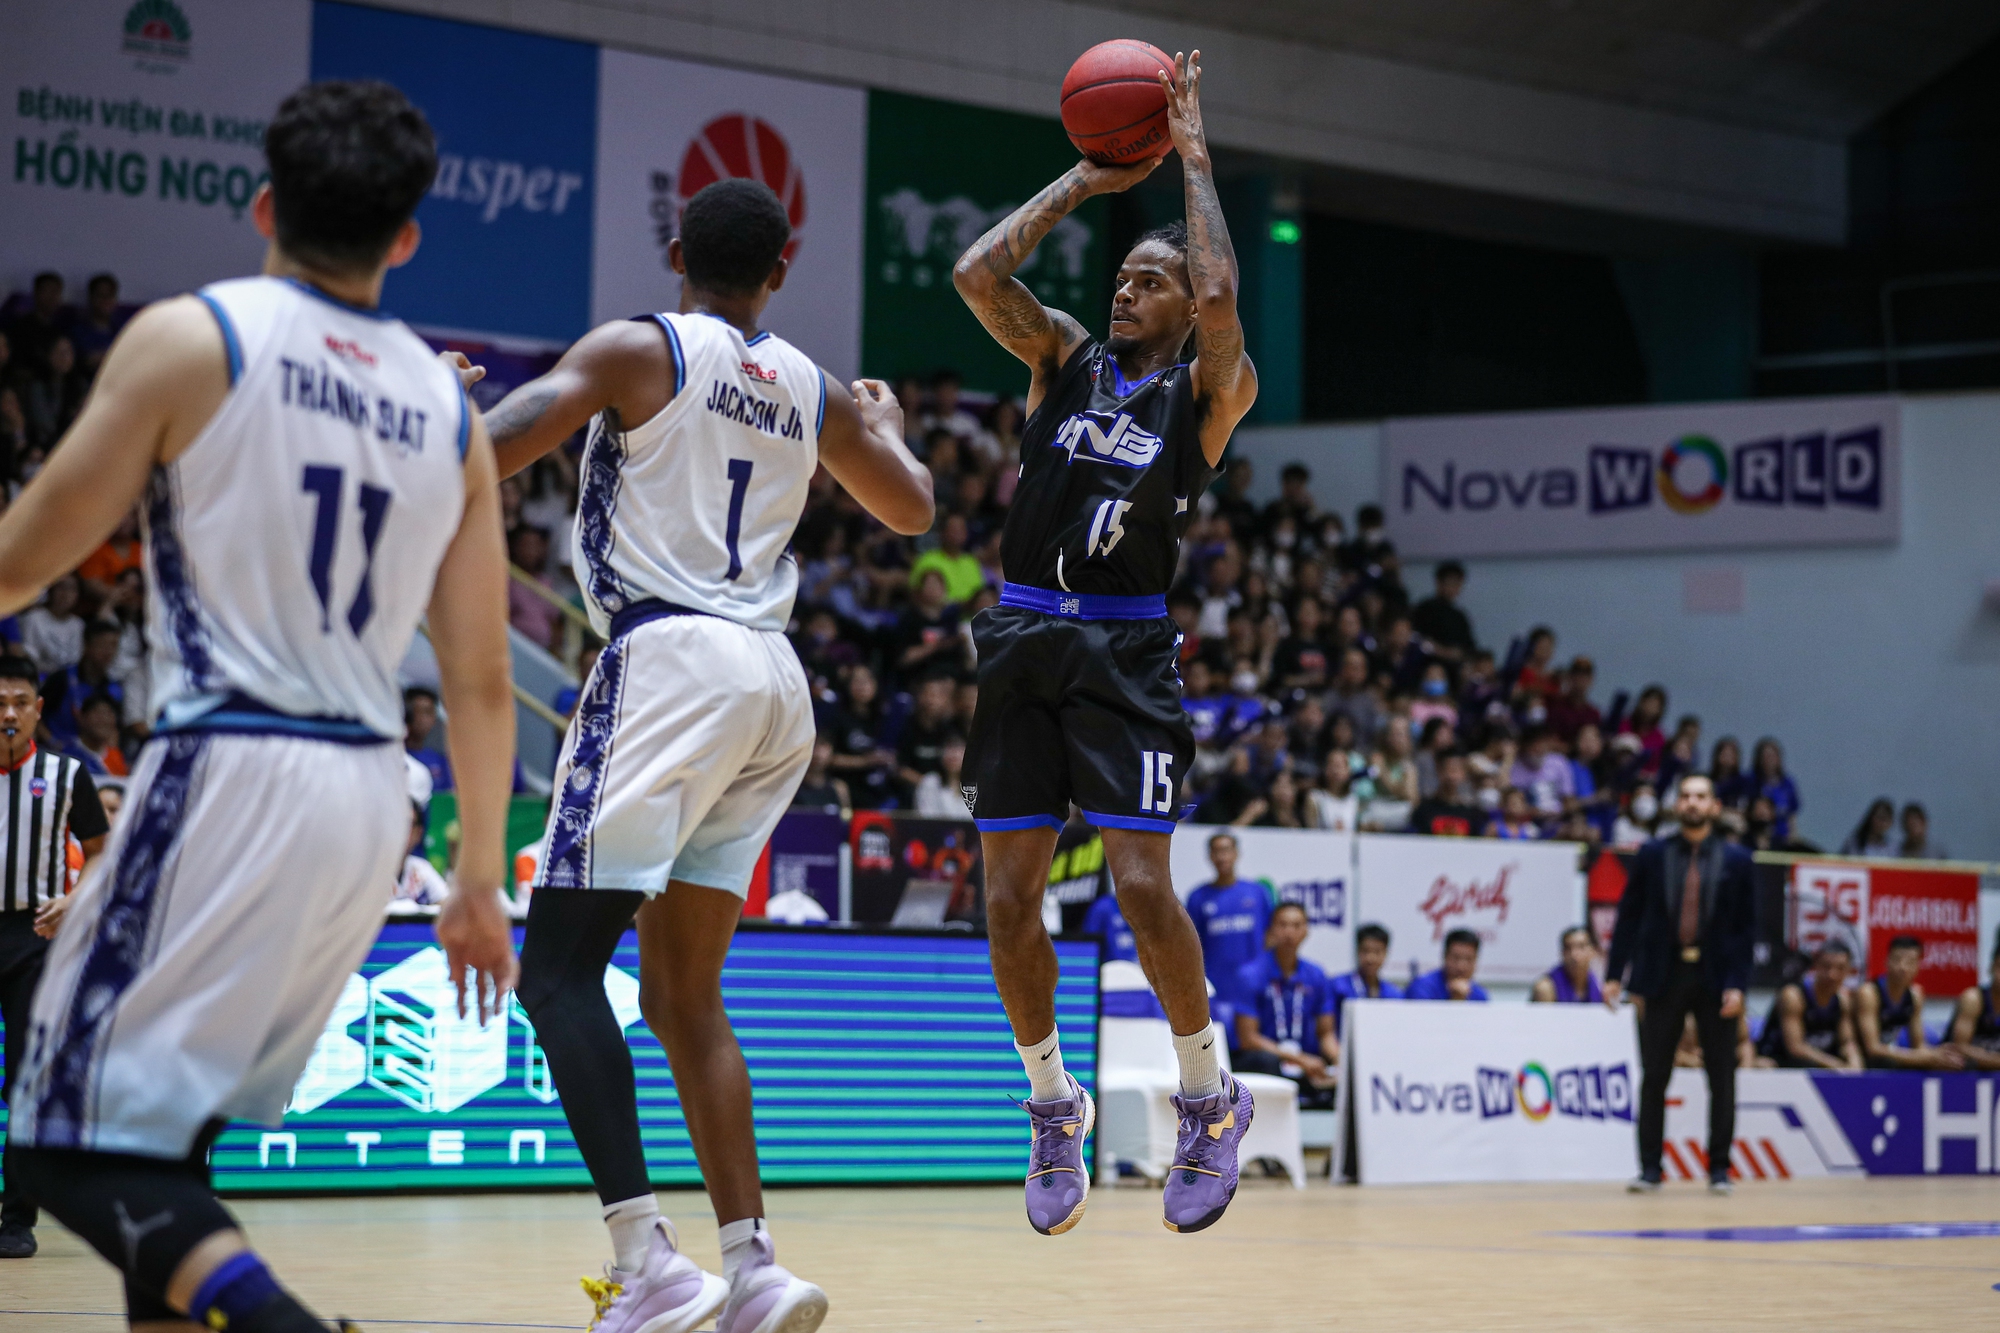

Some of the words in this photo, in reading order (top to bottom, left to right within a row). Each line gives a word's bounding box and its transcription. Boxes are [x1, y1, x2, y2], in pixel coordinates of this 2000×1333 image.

[212, 116, 268, 149] KHO
[1086, 126, 1163, 159] PALDING
[159, 153, 272, 220] NGỌ
[431, 154, 582, 224] asper
[707, 379, 780, 434] JACKSON
[302, 464, 392, 640] 11
[724, 459, 754, 581] 1
[1086, 498, 1134, 559] 15
[1140, 750, 1174, 815] 15
[1922, 1077, 2000, 1172] H
